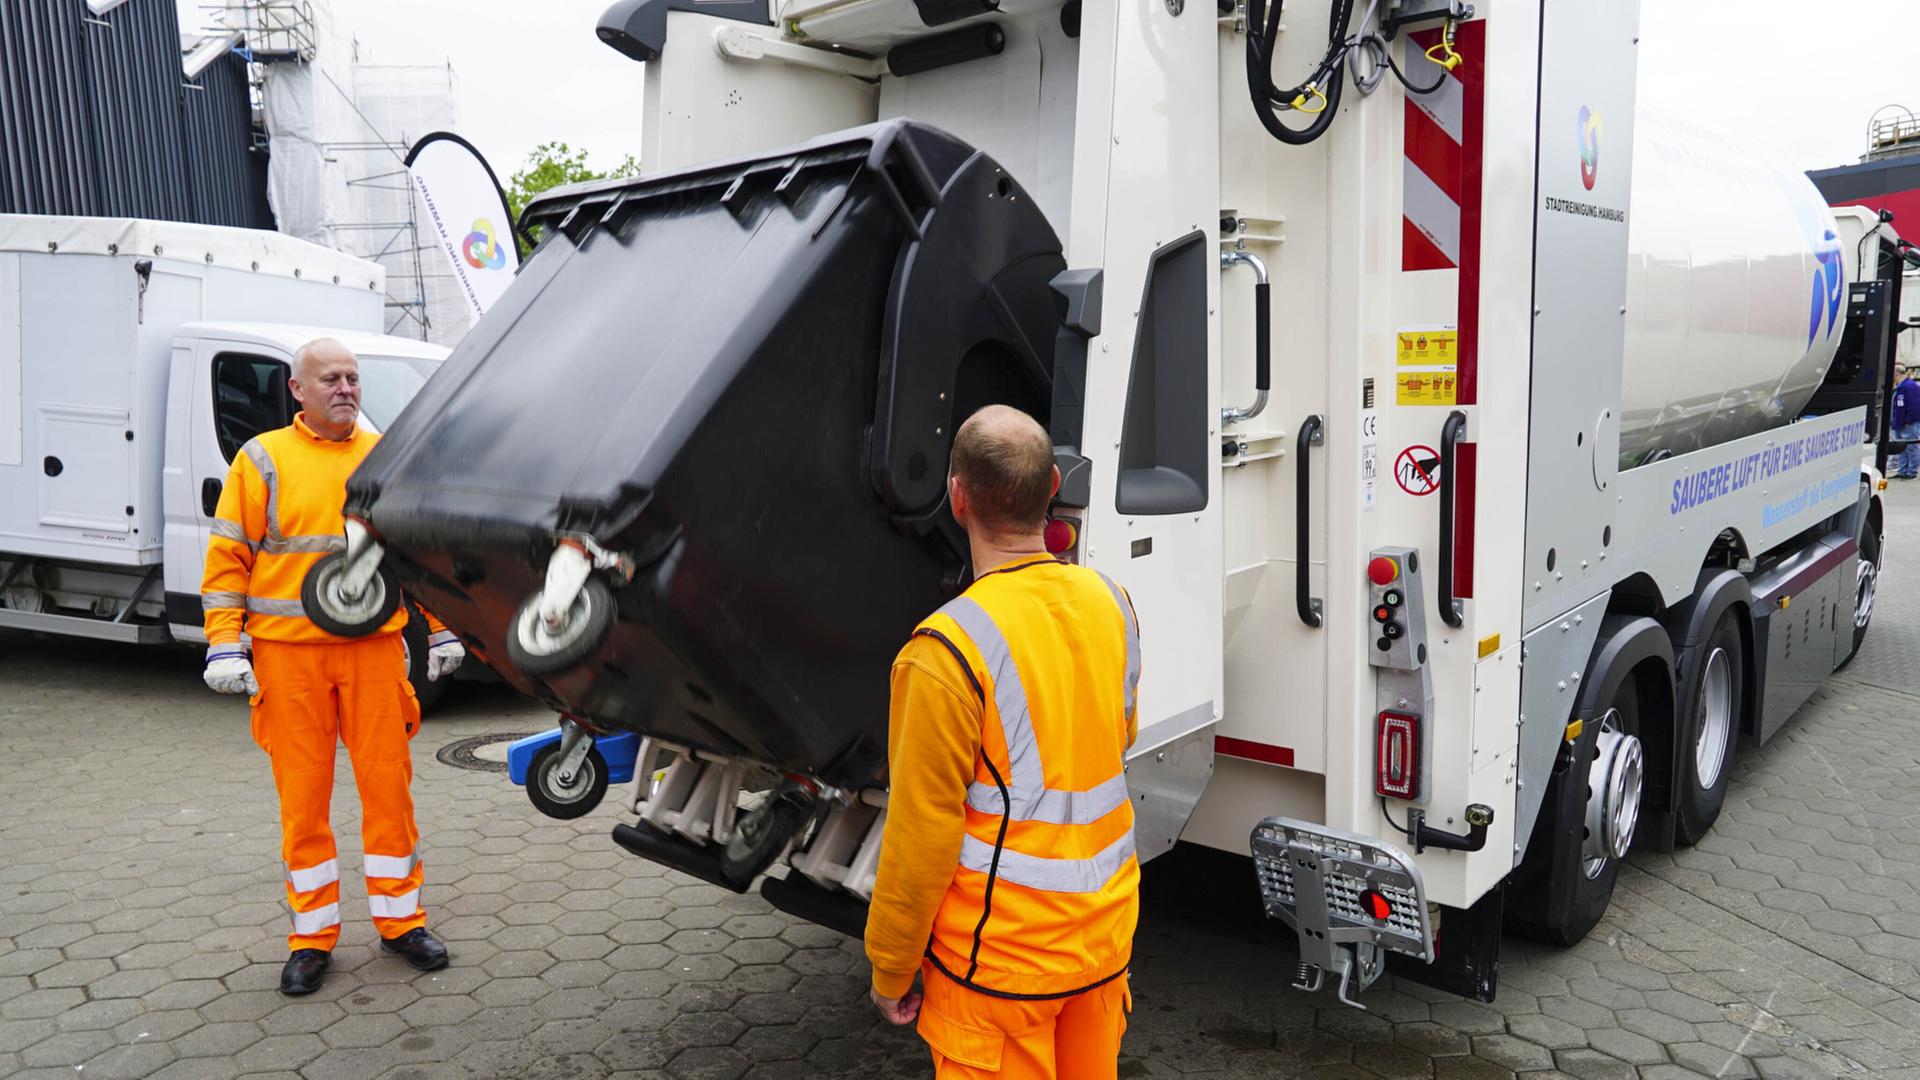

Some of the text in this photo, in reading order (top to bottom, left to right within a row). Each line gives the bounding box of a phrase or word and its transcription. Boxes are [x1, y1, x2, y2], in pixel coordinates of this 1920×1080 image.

[1545, 196, 1624, 222] STADTREINIGUNG HAMBURG
[1671, 420, 1864, 514] SAUBERE LUFT FÜR EINE SAUBERE STADT
